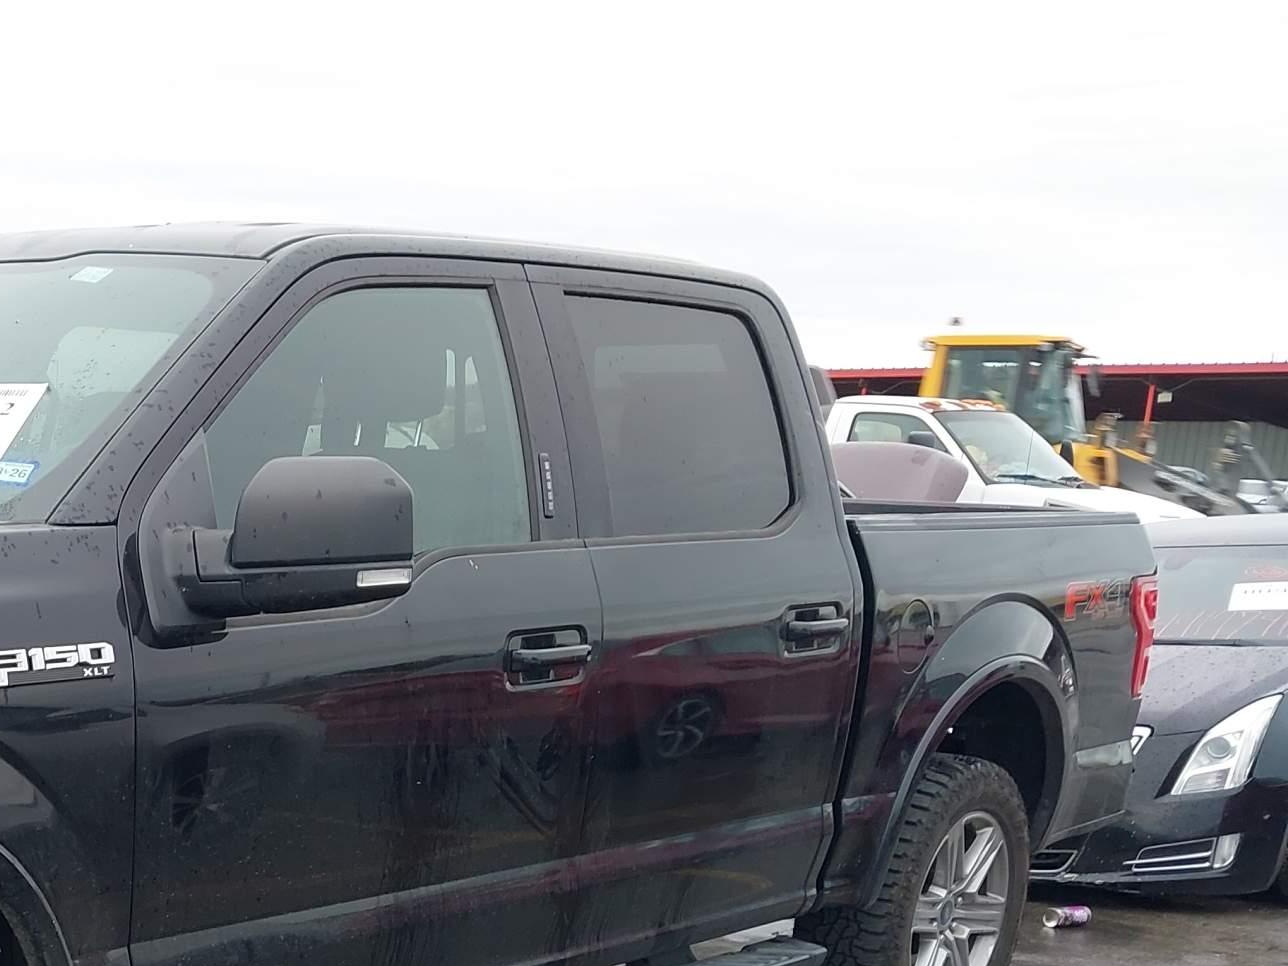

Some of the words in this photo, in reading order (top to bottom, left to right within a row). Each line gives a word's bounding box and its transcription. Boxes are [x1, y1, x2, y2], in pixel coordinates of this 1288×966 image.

[8, 467, 28, 479] 26
[1064, 577, 1124, 622] FX4
[83, 665, 111, 677] XLT
